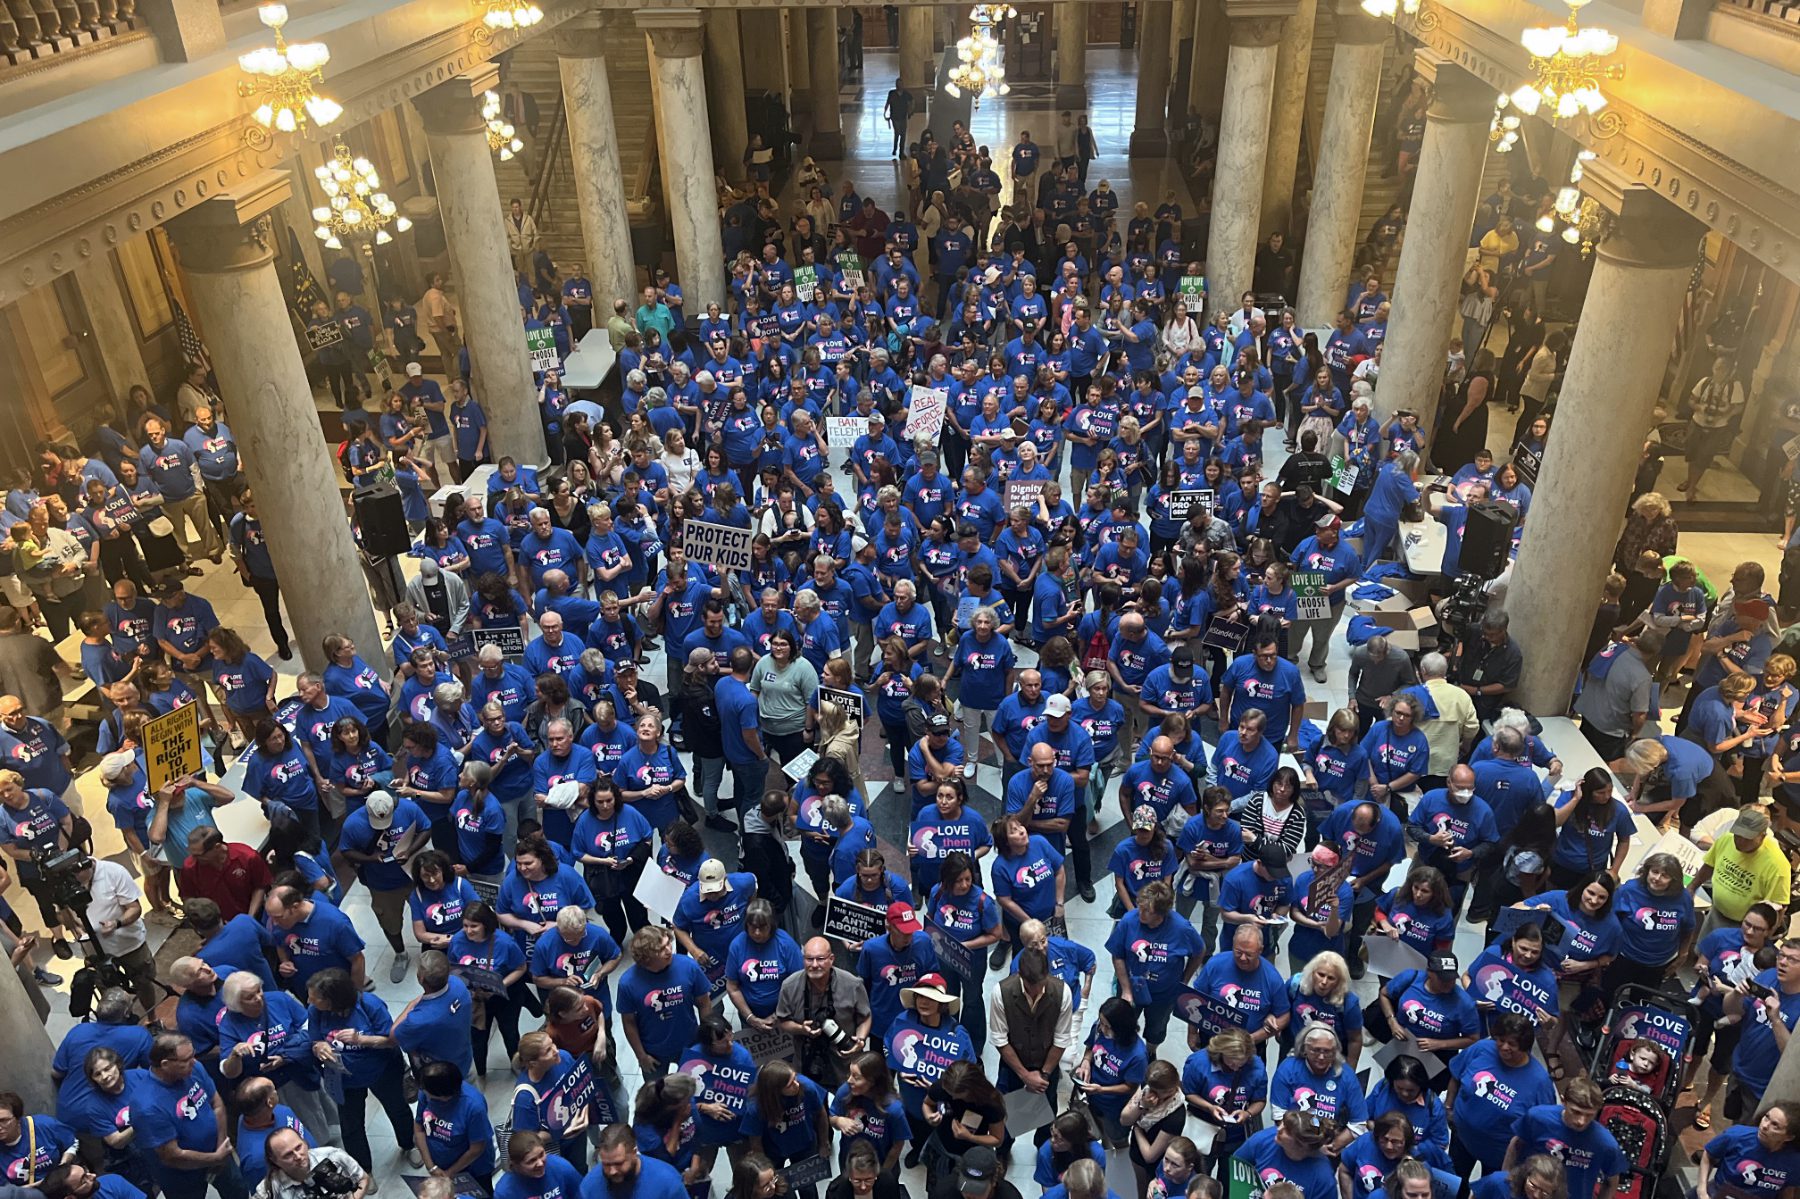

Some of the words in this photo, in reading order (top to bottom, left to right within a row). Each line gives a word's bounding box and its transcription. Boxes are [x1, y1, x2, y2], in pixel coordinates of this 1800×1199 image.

[1182, 277, 1193, 286] LOVE
[1193, 277, 1203, 286] LIFE
[759, 315, 777, 324] LOVE
[526, 330, 540, 341] LOVE
[541, 328, 553, 339] LIFE
[761, 328, 780, 336] BOTH
[539, 359, 550, 369] LIFE
[914, 396, 939, 409] REAL
[709, 401, 720, 419] LOVE
[720, 402, 732, 421] BOTH
[1093, 410, 1113, 420] LOVE
[838, 418, 858, 427] BAN
[1094, 418, 1112, 427] them
[829, 427, 869, 436] TELEME
[1090, 425, 1110, 434] BOTH
[1011, 484, 1042, 494] Dignity
[105, 498, 126, 513] LOVE
[114, 510, 138, 526] BOTH
[686, 524, 749, 549] PROTECT
[644, 539, 664, 558] BOTH
[685, 543, 713, 562] OUR
[716, 548, 748, 567] KIDS
[1292, 574, 1309, 585] LOVE
[1311, 574, 1324, 585] LIFE
[1298, 598, 1325, 608] CHOOSE
[1305, 609, 1320, 618] LIFE
[1258, 682, 1274, 690] LOVE
[503, 697, 518, 706] BOTH
[831, 695, 854, 706] VOTE
[151, 722, 163, 735] ALL
[167, 708, 192, 727] RIGHTS
[151, 728, 172, 744] BEGIN
[174, 717, 192, 732] WITH
[162, 731, 184, 750] THE
[156, 739, 191, 766] RIGHT
[1393, 748, 1408, 758] LOVE
[168, 756, 182, 770] TO
[284, 759, 299, 769] LOVE
[1329, 758, 1346, 768] LOVE
[1389, 759, 1406, 769] BOTH
[165, 763, 189, 781] LIFE
[287, 767, 304, 778] BOTH
[1236, 766, 1252, 774] LOVE
[1328, 770, 1343, 779] BOTH
[1232, 775, 1248, 784] BOTH
[31, 813, 49, 827] LOVE
[1450, 818, 1469, 828] LOVE
[35, 821, 56, 836] BOTH
[937, 824, 969, 836] LOVE
[942, 837, 971, 847] them
[939, 848, 972, 858] BOTH
[1029, 858, 1045, 872] LOVE
[1035, 869, 1052, 883] BOTH
[442, 900, 460, 909] LOVE
[540, 904, 558, 912] BOTH
[720, 904, 737, 914] LOVE
[445, 911, 463, 921] BOTH
[723, 914, 740, 924] BOTH
[834, 906, 847, 915] THE
[848, 911, 874, 923] FUTURE
[956, 909, 973, 917] LOVE
[842, 916, 872, 929] ANTI-
[954, 921, 973, 930] BOTH
[1410, 919, 1430, 932] LOVE
[828, 920, 880, 939] ABORTIO
[1577, 929, 1598, 942] LOVE
[1406, 931, 1426, 942] BOTH
[524, 934, 535, 957] LOVE
[944, 933, 971, 960] LOVE
[1571, 938, 1592, 954] BOTH
[943, 952, 972, 978] BOTH
[662, 985, 682, 995] LOVE
[1240, 988, 1261, 998] LOVE
[1512, 973, 1549, 1004] LOVE
[664, 997, 684, 1006] BOTH
[1238, 1002, 1260, 1011] BOTH
[1206, 1000, 1243, 1025] LOVE
[1422, 1007, 1445, 1022] LOVE
[1500, 996, 1539, 1028] BOTH
[1418, 1022, 1442, 1033] BOTH
[1643, 1012, 1684, 1036] LOVE
[1646, 1025, 1681, 1048] them
[750, 1034, 791, 1053] EDICA
[923, 1033, 959, 1056] LOVE
[925, 1050, 953, 1066] them
[562, 1060, 587, 1094] LOVE
[712, 1063, 751, 1084] LOVE
[917, 1061, 945, 1084] BOT
[570, 1073, 592, 1098] them
[714, 1078, 747, 1097] them
[1494, 1081, 1518, 1098] LOVE
[569, 1080, 595, 1114] BOTH
[704, 1089, 744, 1112] BOTH
[1487, 1094, 1510, 1111] BOTH
[788, 1156, 821, 1176] LOVE
[1232, 1159, 1258, 1186] LOVE
[790, 1169, 828, 1190] BOTH
[1762, 1167, 1787, 1179] LOVE
[1757, 1180, 1781, 1191] BOTH
